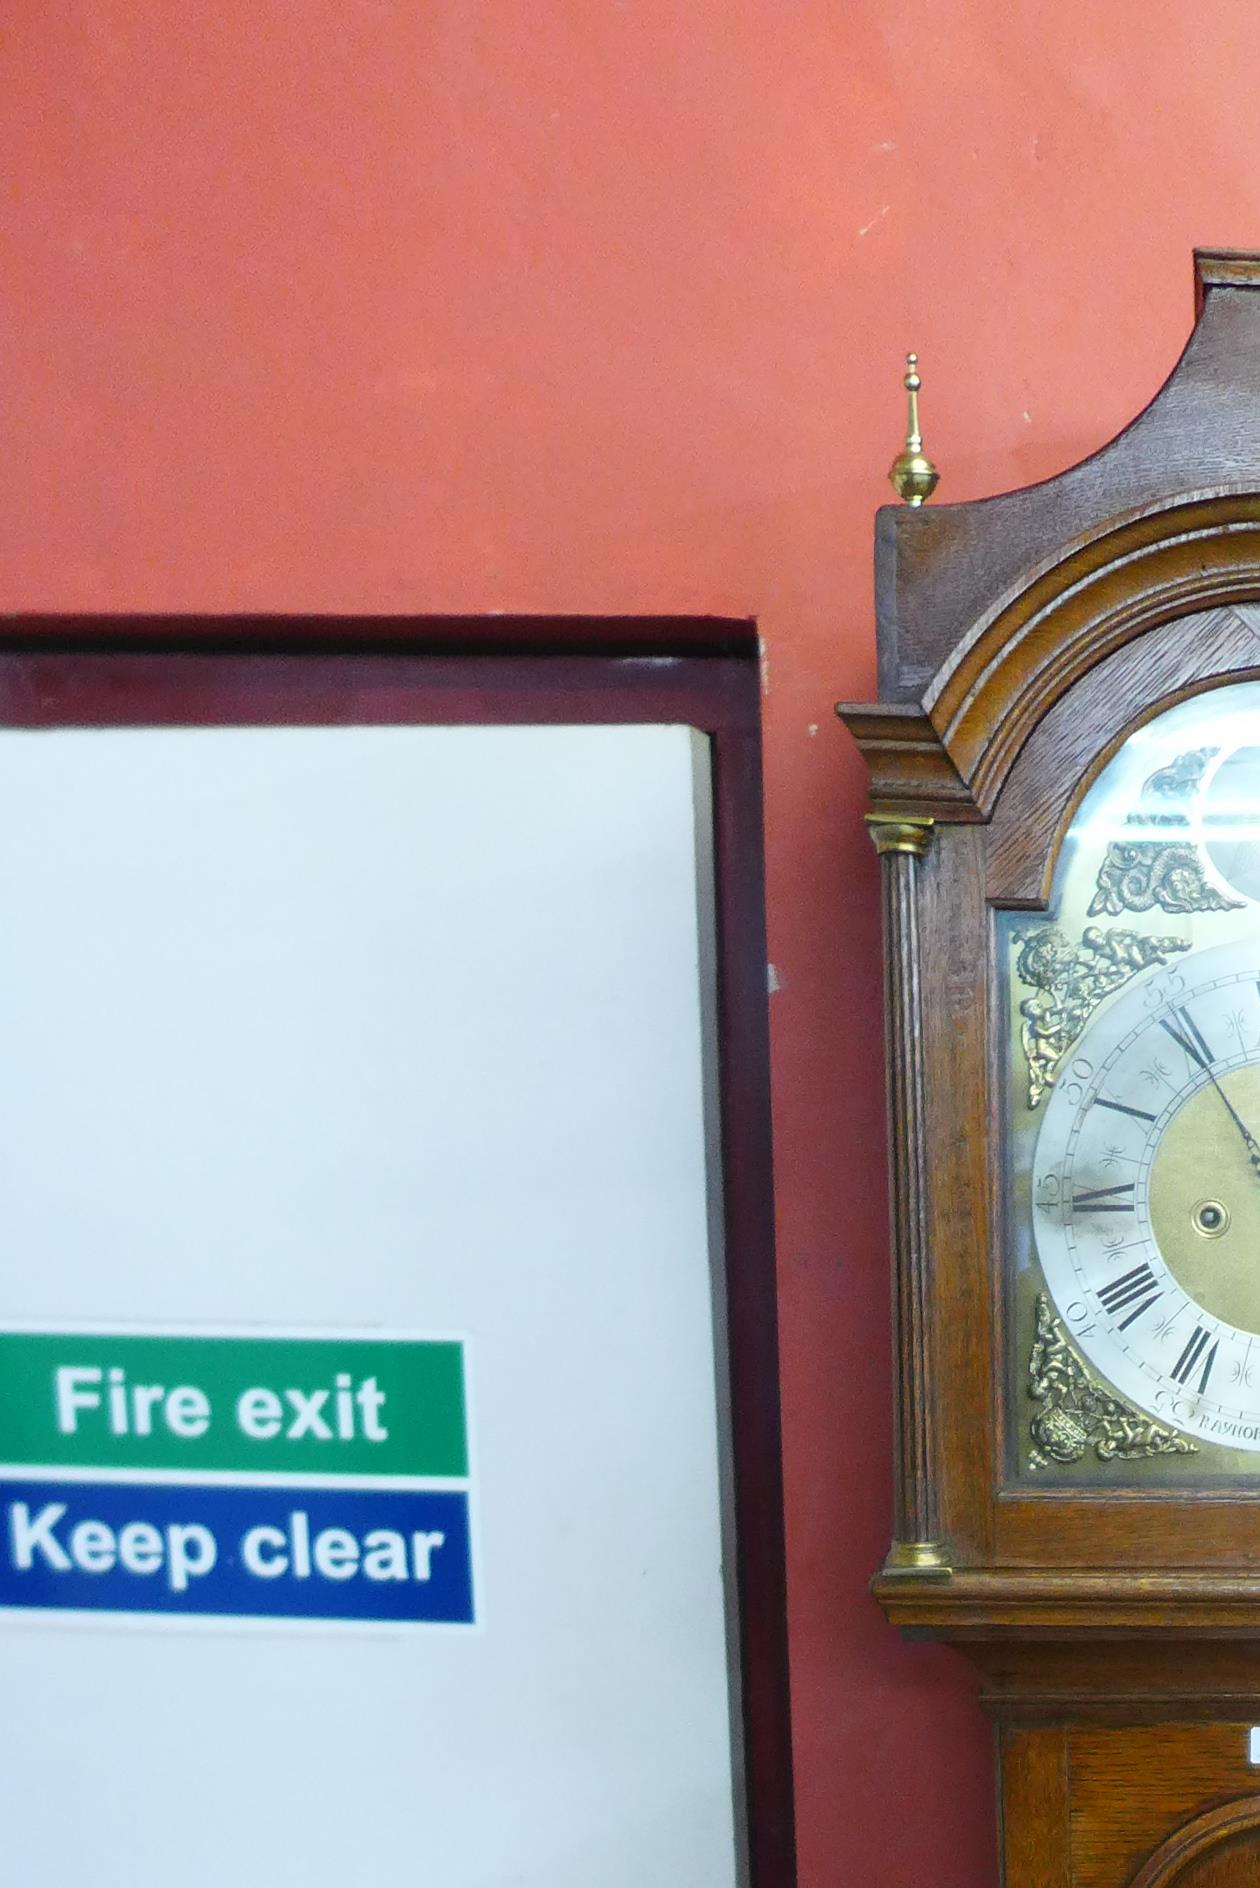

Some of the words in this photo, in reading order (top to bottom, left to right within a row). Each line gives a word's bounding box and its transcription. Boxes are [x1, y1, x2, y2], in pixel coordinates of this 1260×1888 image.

[1143, 965, 1186, 1009] 55
[1058, 1057, 1095, 1107] 50
[1034, 1173, 1062, 1216] 45
[1071, 1182, 1136, 1213] IX
[1066, 1300, 1098, 1338] 40
[1096, 1262, 1167, 1333] VIII
[1169, 1325, 1221, 1396] VII
[55, 1365, 212, 1438] Fire
[237, 1372, 389, 1442] exit
[8, 1501, 218, 1592] Keep
[242, 1510, 446, 1581] clear
